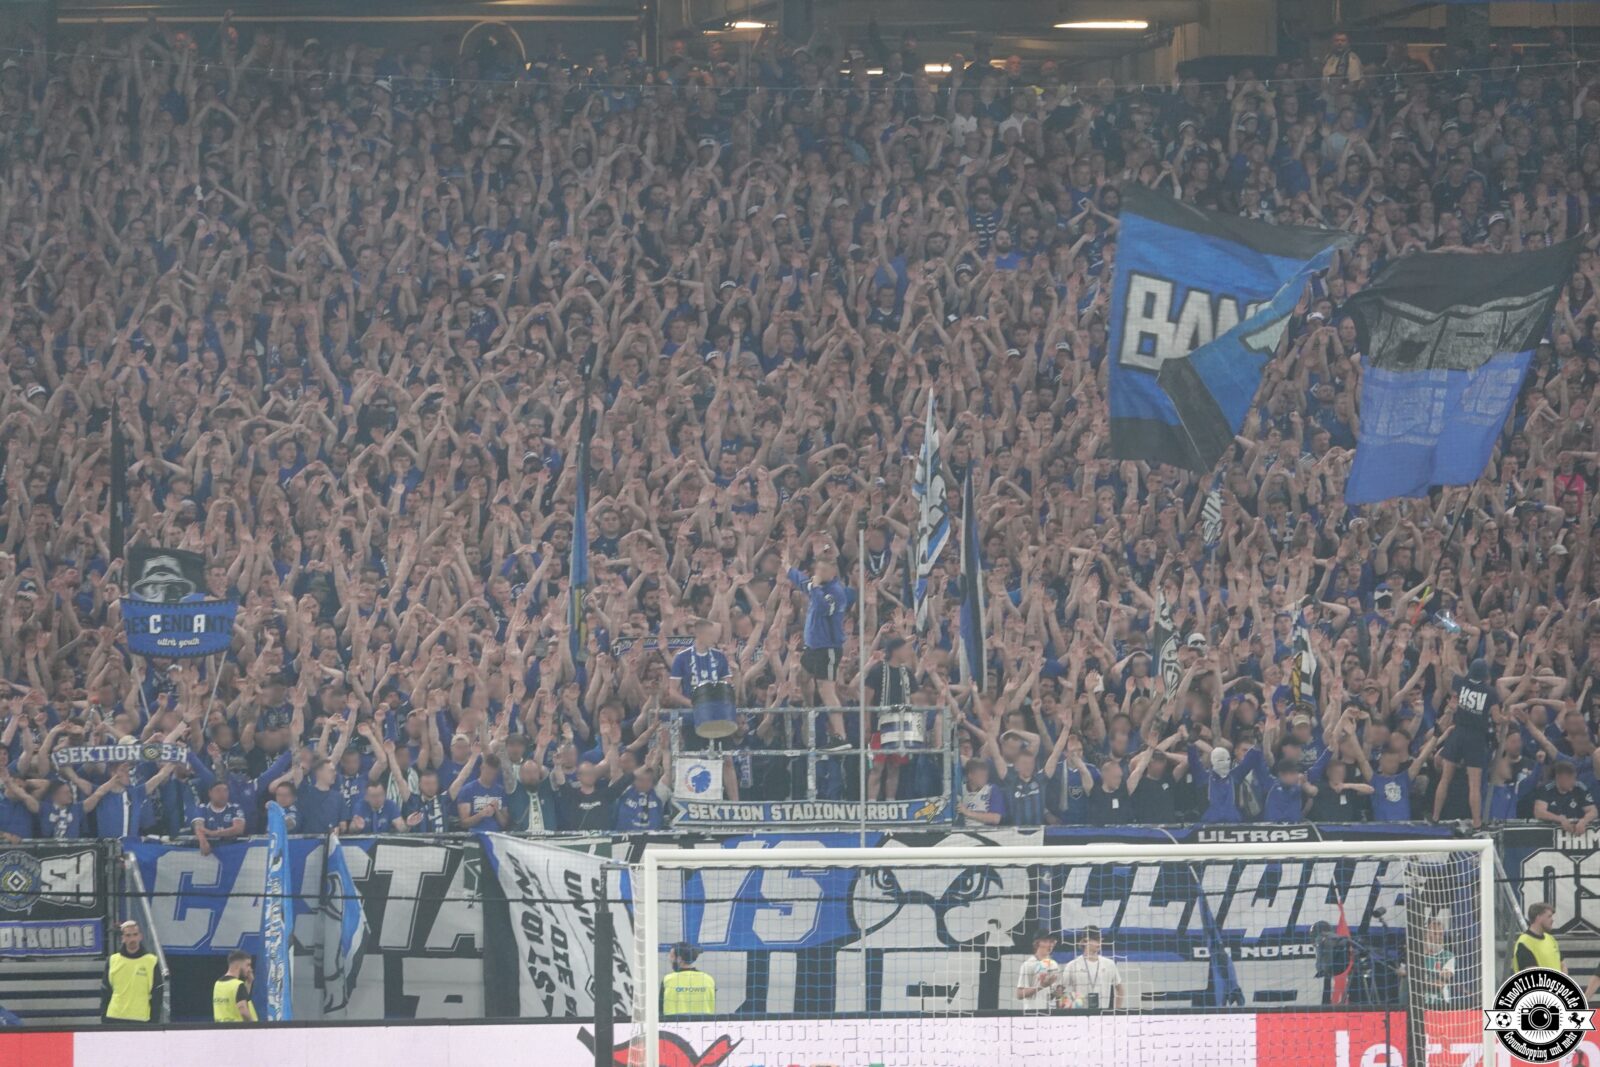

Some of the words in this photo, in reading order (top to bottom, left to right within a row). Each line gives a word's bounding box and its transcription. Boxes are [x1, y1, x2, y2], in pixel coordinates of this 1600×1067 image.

[1459, 686, 1488, 711] HSV
[59, 745, 141, 764] SEKTION
[688, 803, 764, 820] SEKTION
[770, 802, 909, 821] STADIONVERBOT
[1198, 828, 1309, 843] ULTRAS
